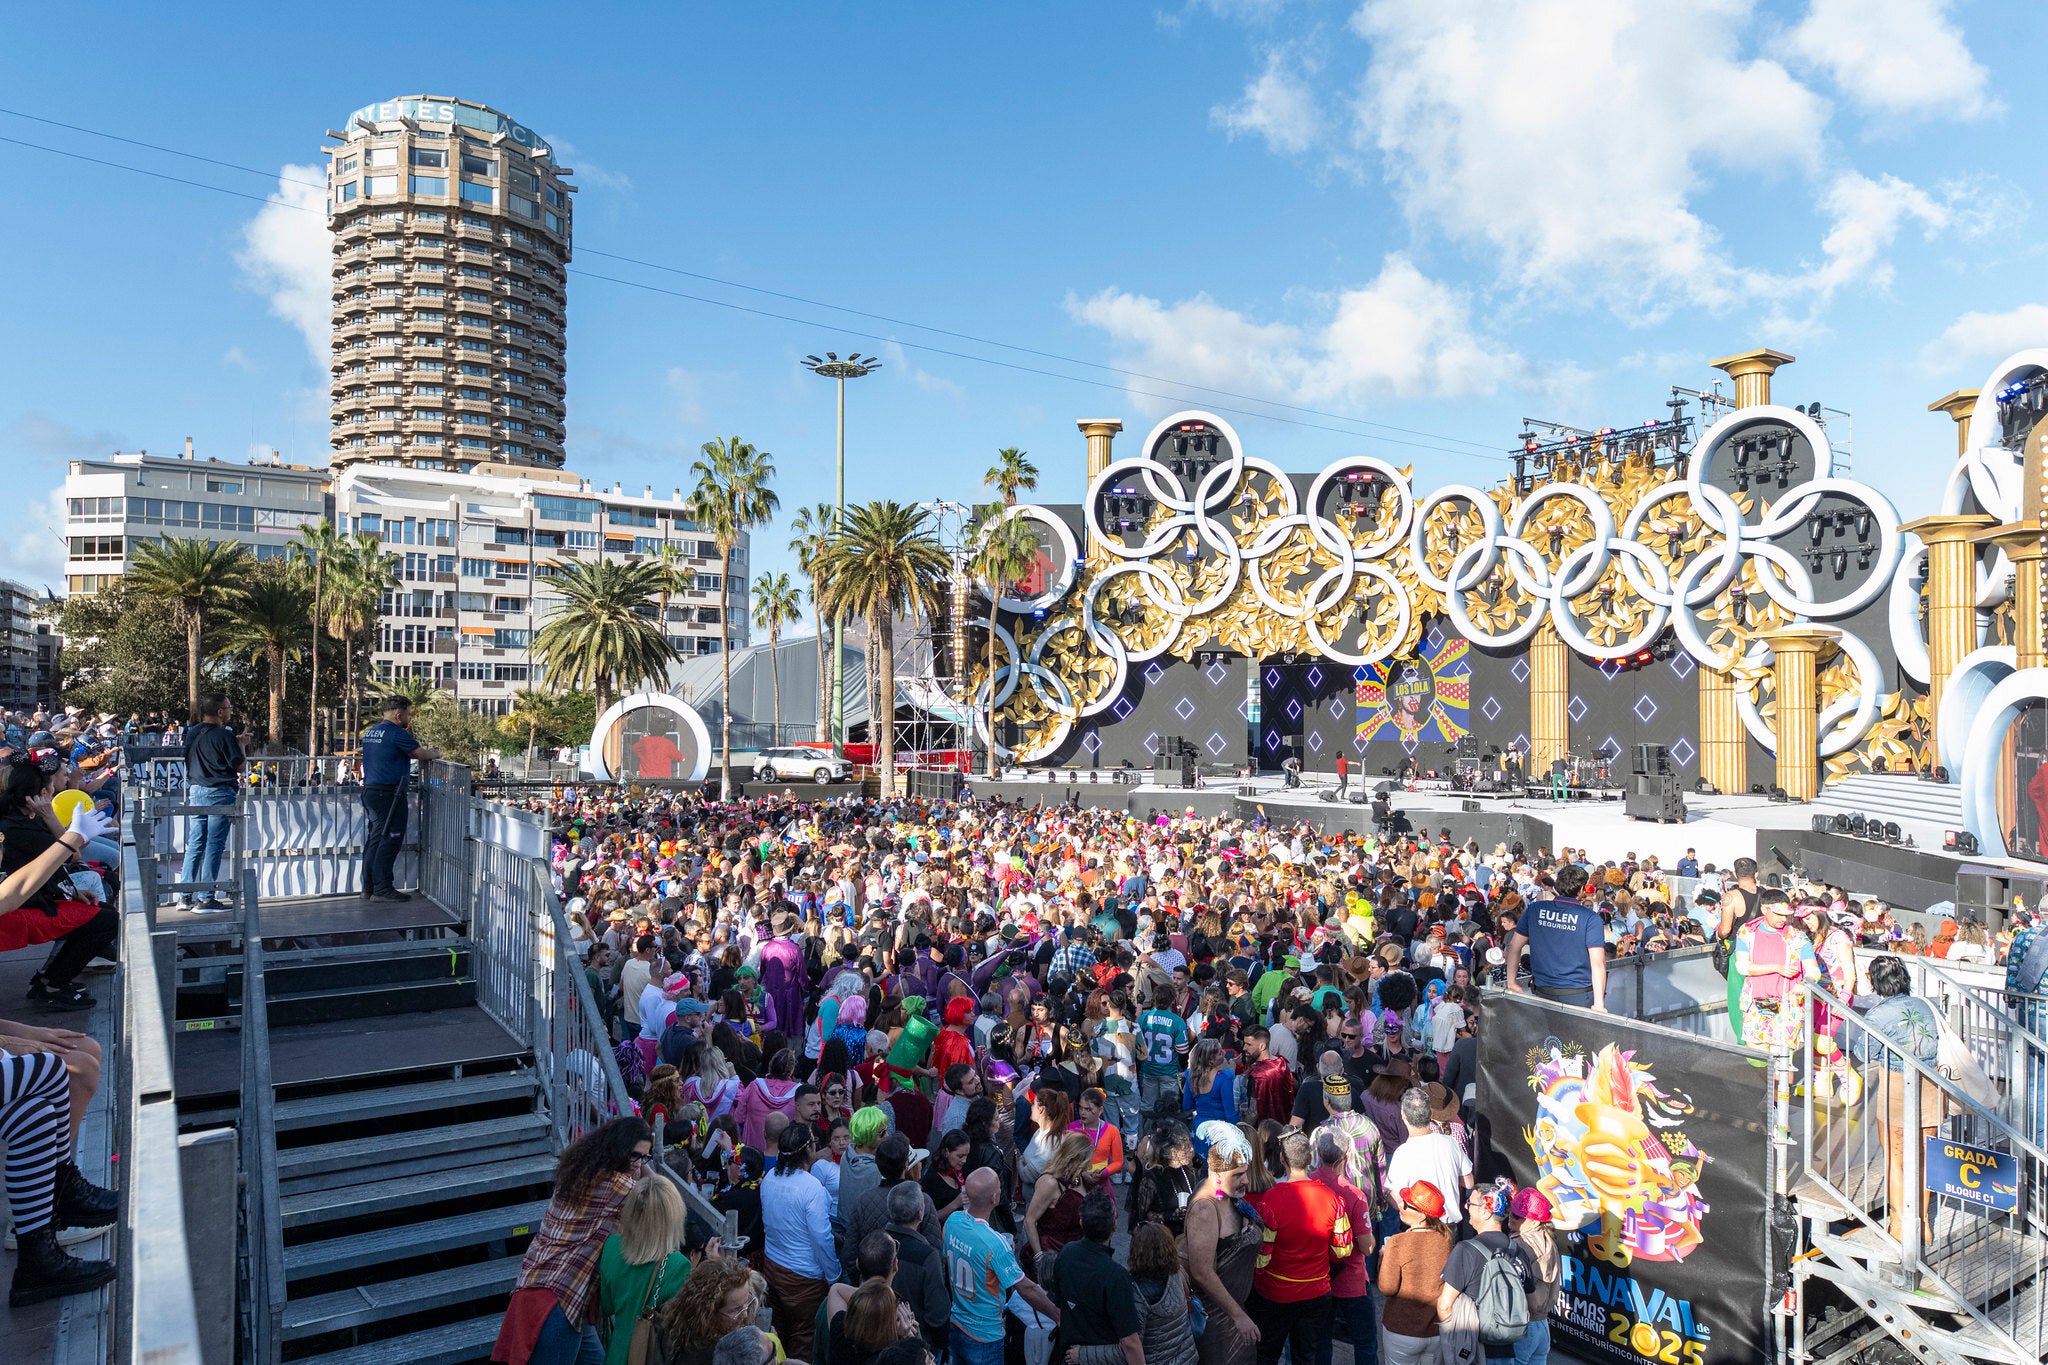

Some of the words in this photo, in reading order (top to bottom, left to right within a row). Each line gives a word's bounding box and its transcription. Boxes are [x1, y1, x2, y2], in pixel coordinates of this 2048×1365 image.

[499, 120, 526, 142] AC
[1395, 683, 1410, 696] LOS
[1410, 680, 1429, 694] LOLA
[1538, 920, 1577, 931] SEGURIDAD
[1539, 909, 1579, 924] EULEN
[1147, 1014, 1173, 1028] MARINO
[1144, 1031, 1173, 1064] 13
[1944, 1145, 1998, 1169] GRADA
[1960, 1163, 1981, 1189] C
[1945, 1183, 1981, 1201] BLOQUE
[1983, 1193, 1994, 1204] C1
[1363, 1211, 1372, 1228] 3
[949, 1234, 972, 1257] MESSI
[946, 1249, 976, 1301] 10
[1559, 1254, 1711, 1341] RNAVAL
[1696, 1322, 1711, 1335] de
[1564, 1309, 1605, 1336] CANARIA
[1556, 1321, 1590, 1342] INTERÉS
[1590, 1336, 1633, 1360] TURÍSTICO
[1608, 1312, 1707, 1365] 2025
